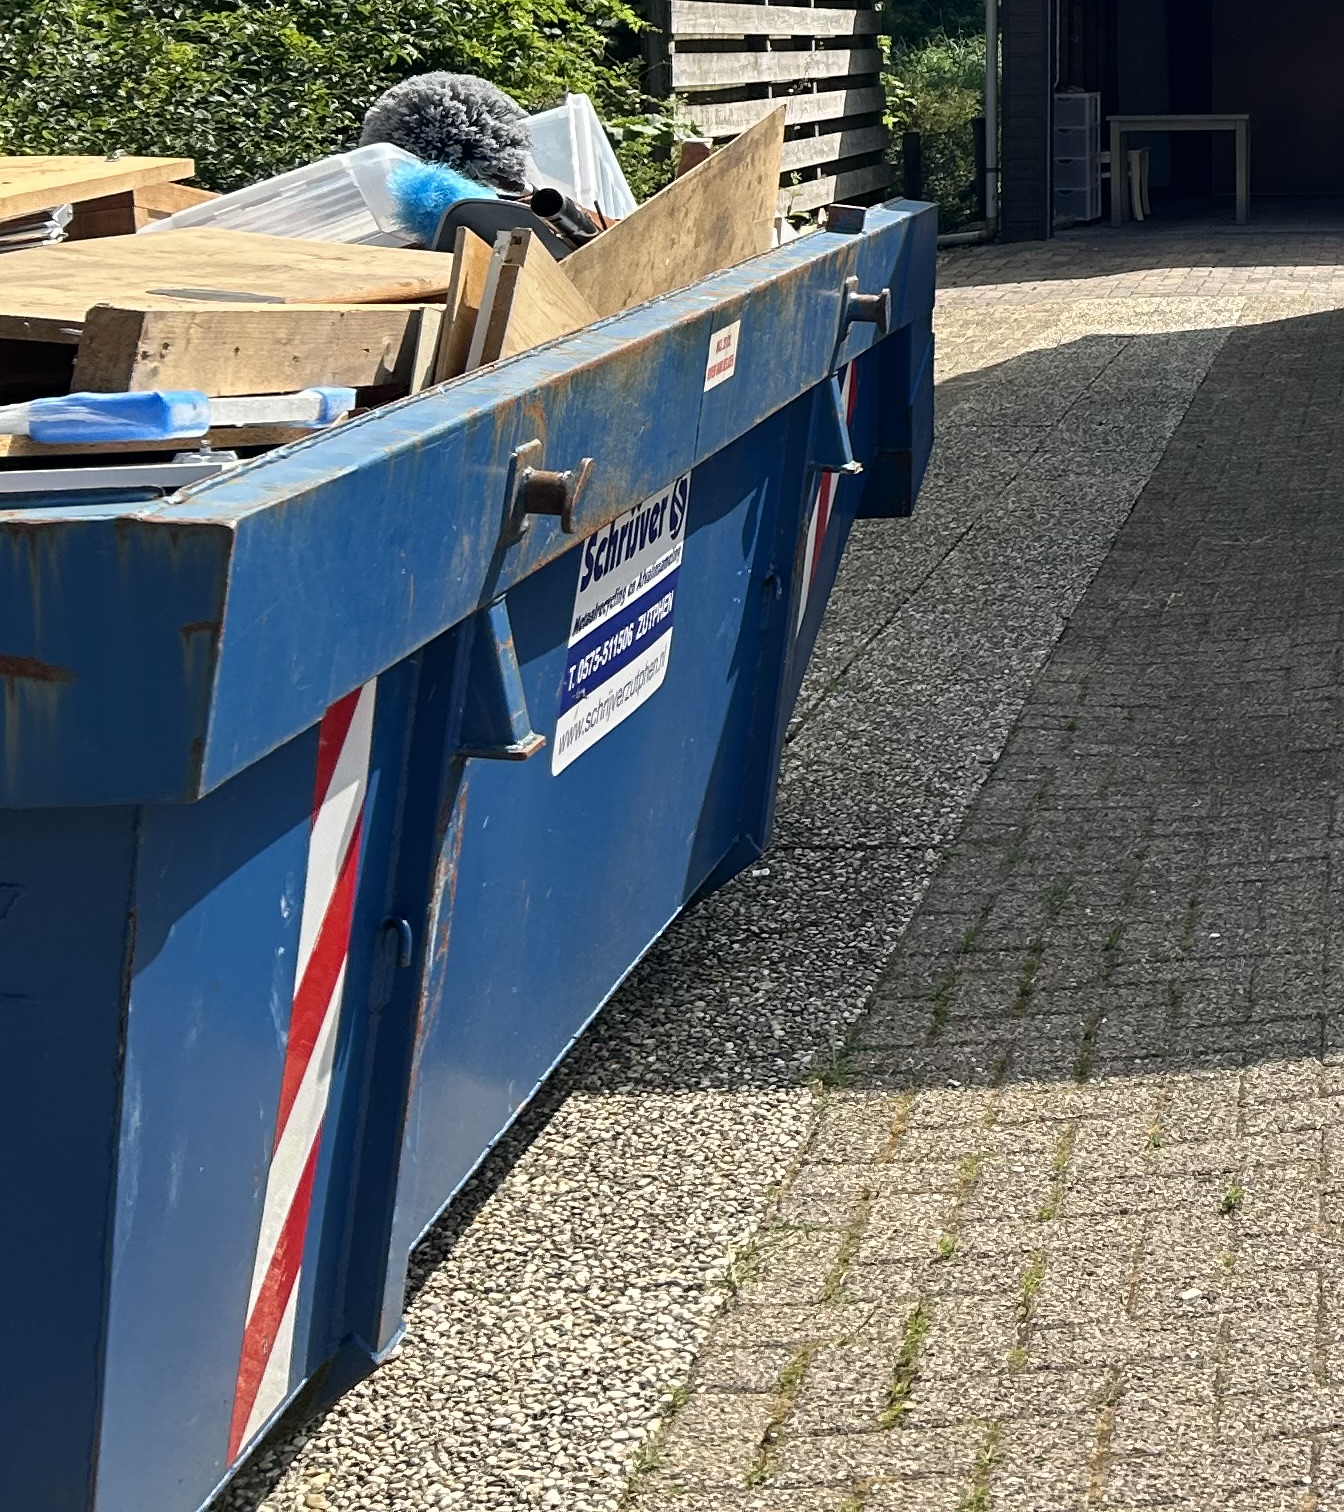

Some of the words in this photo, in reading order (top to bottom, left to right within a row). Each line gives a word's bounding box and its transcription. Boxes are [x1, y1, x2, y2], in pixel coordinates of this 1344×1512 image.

[568, 665, 576, 691] T.
[576, 623, 634, 684] 0575-511506
[635, 590, 675, 640] ZUTPHEN
